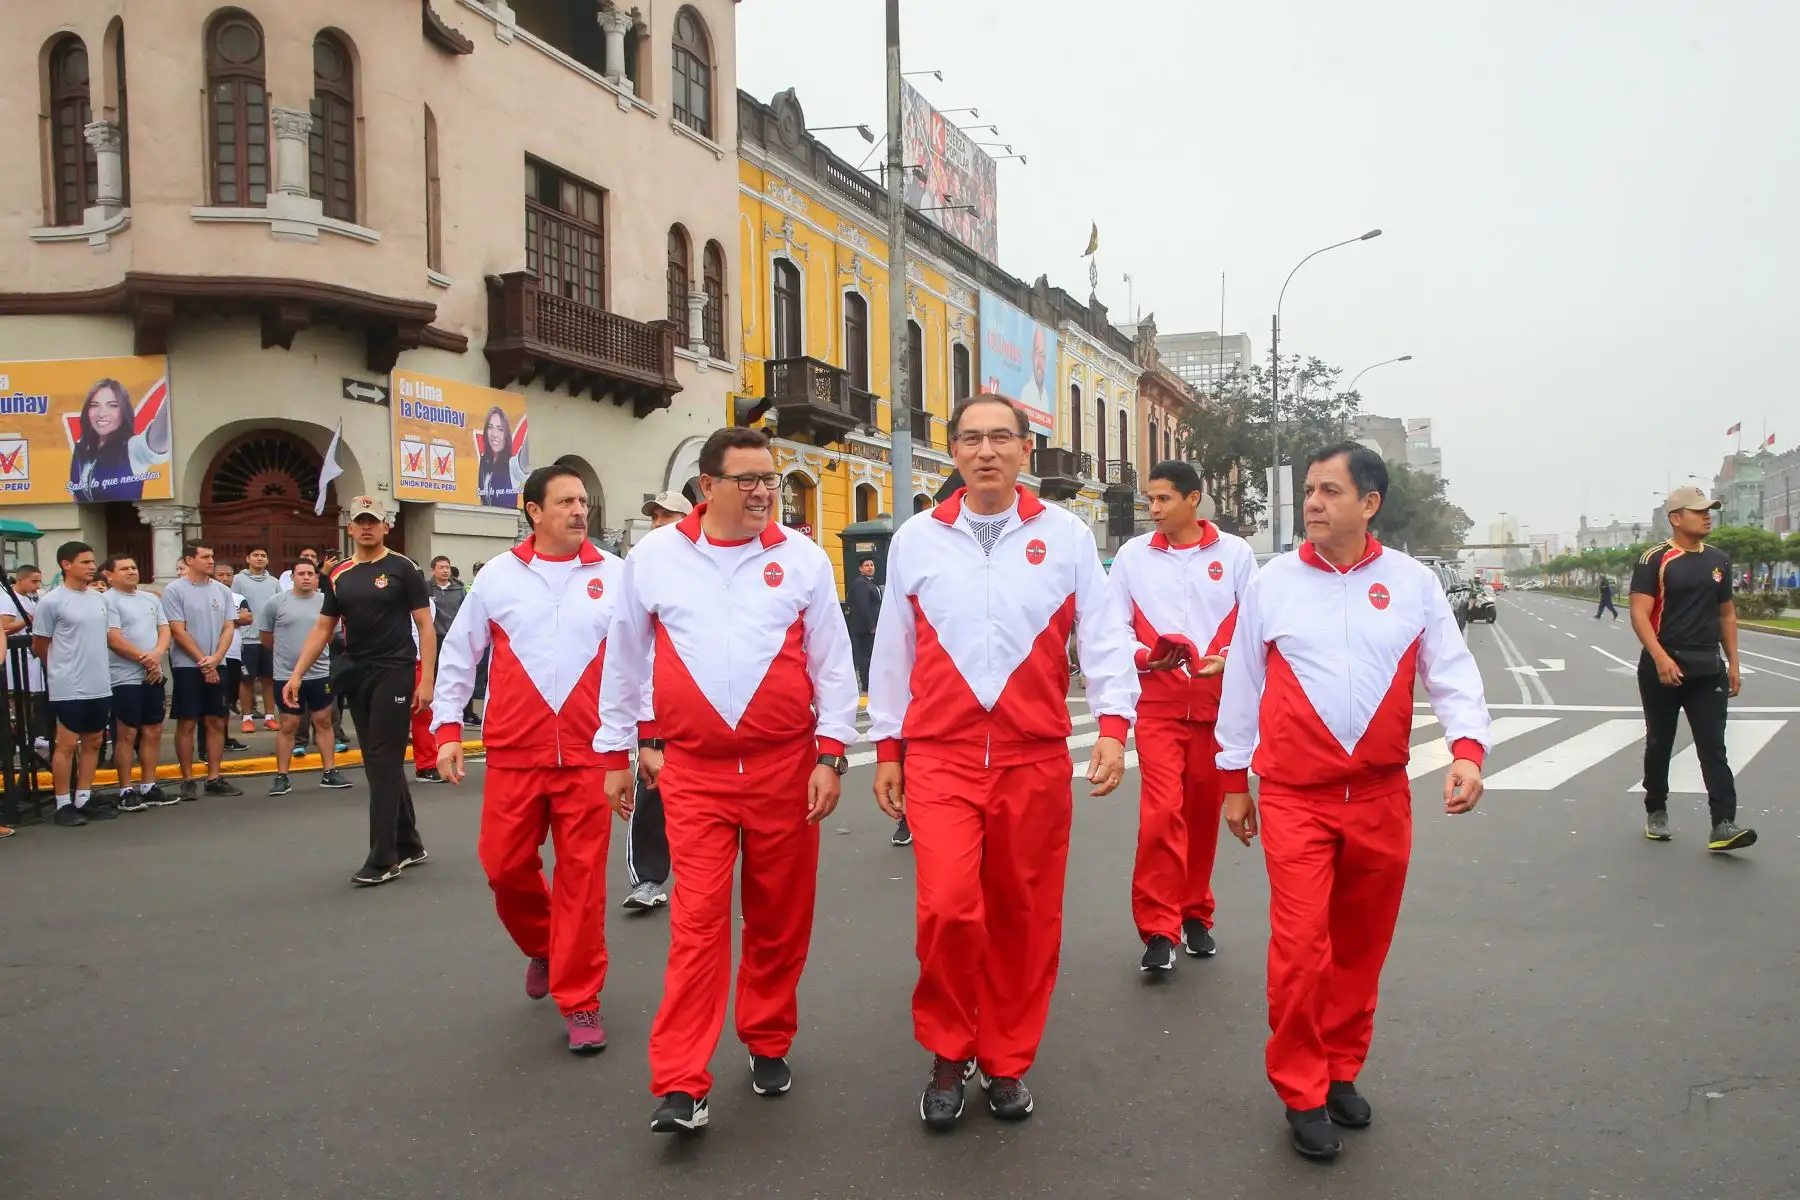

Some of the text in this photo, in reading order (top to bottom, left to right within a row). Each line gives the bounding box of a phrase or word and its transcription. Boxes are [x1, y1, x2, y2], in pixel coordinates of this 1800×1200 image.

[400, 378, 443, 401] En Lima
[400, 399, 465, 428] la Capuñay
[101, 477, 118, 489] que
